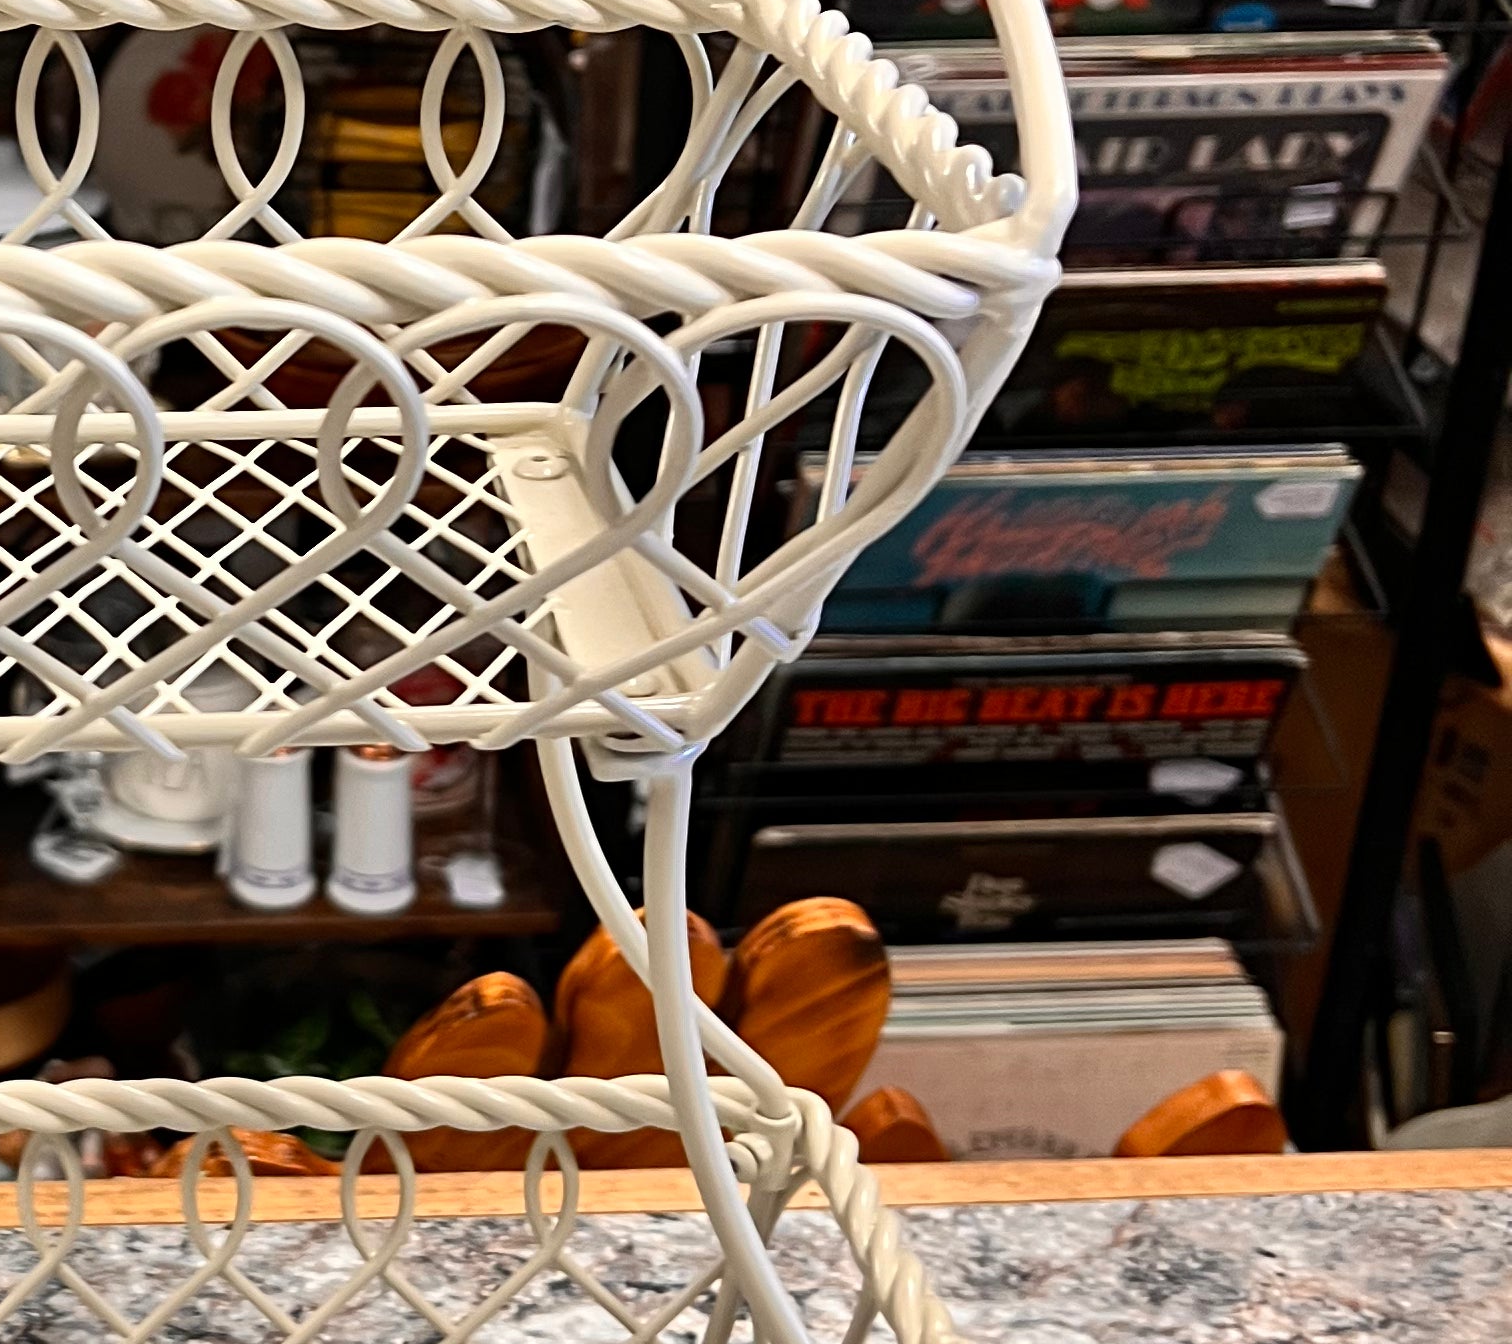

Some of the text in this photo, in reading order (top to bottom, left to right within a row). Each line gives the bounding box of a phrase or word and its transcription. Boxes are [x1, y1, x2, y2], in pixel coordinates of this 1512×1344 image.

[794, 679, 1285, 728] THE BIG BEAT IS HERE
